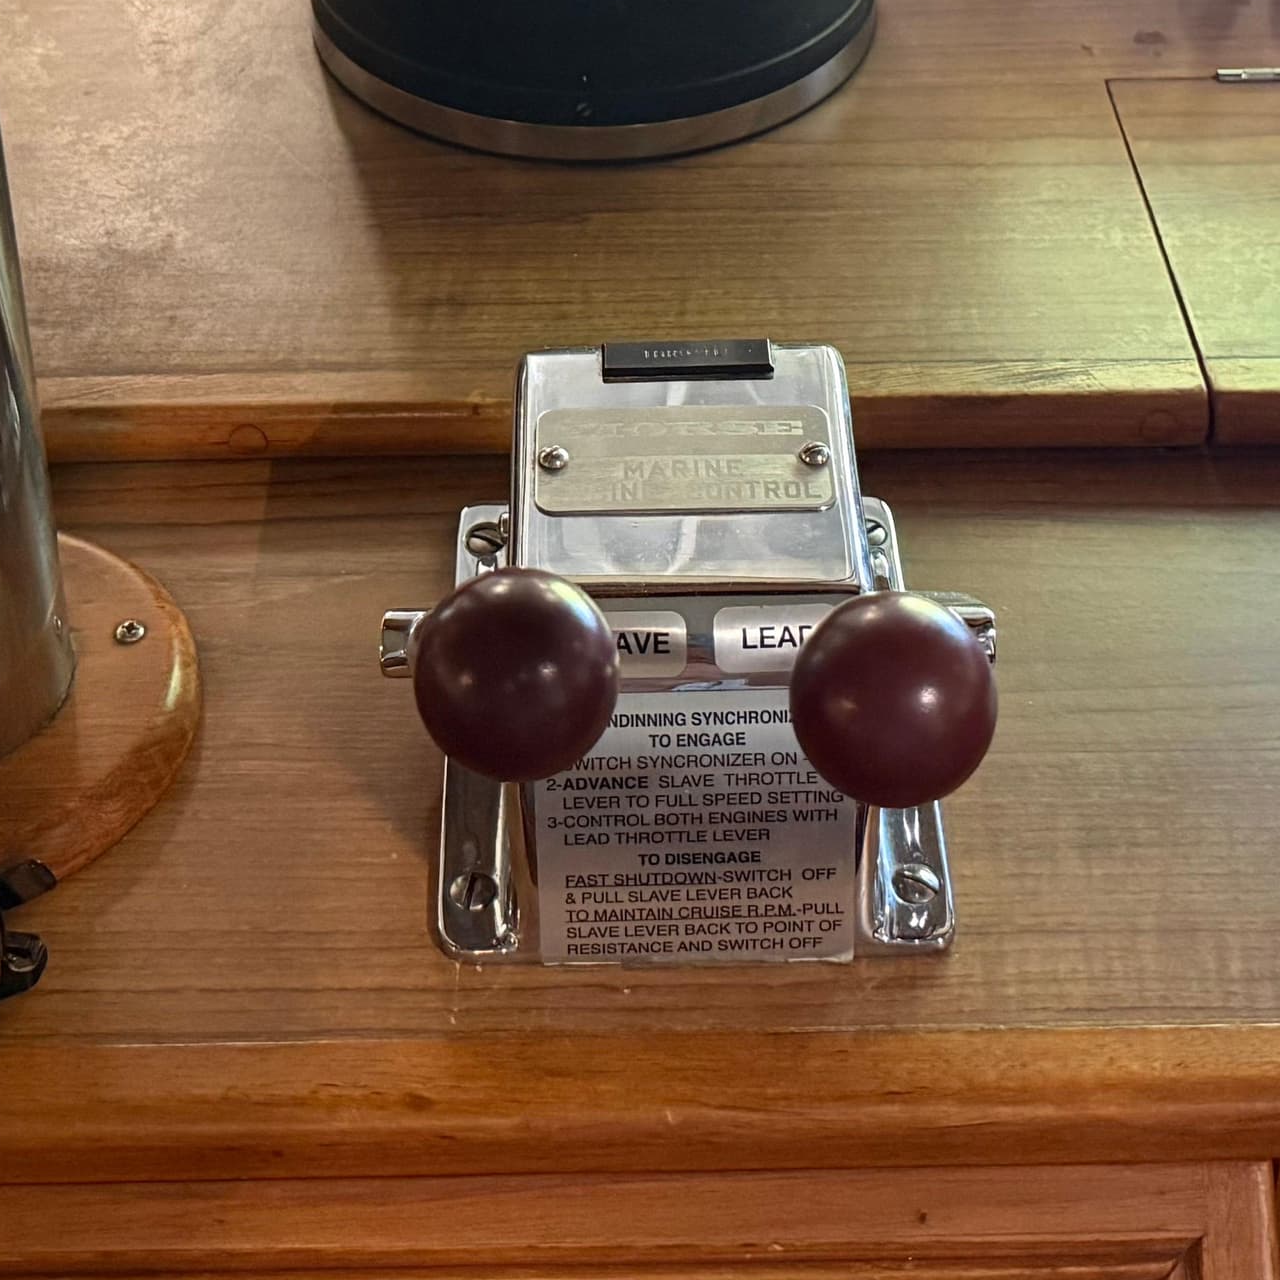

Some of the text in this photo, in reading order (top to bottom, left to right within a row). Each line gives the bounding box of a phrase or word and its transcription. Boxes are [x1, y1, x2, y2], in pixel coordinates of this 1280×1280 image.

[623, 459, 745, 479] MARINE
[617, 632, 670, 655] AVE
[648, 732, 746, 748] TO ENGAGE
[636, 753, 766, 769] SYNCRONIZER
[771, 751, 798, 765] ON
[546, 772, 818, 791] 2-ADVANCE SLAVE THROTTLE
[563, 790, 844, 810] LEVER TO FULL SPEED SETTING
[547, 808, 838, 829] 3-CONTROL BOTH ENGINES WITH
[564, 828, 771, 846] LEAD THROTTLE LEVER
[638, 851, 762, 867] TO DISENGAGE
[565, 868, 837, 888] FAST SHUTDOWN-SWITCH OFF
[565, 886, 793, 905] & PULL SLAVE LEVER BACK
[566, 903, 845, 923] TO MAINTAIN CRUISE R.P.M.-PULL
[566, 919, 842, 939] SLAVE LEVER BACK TO POINT OF
[567, 936, 823, 955] RESISTANCE AND SWITCH OFF
